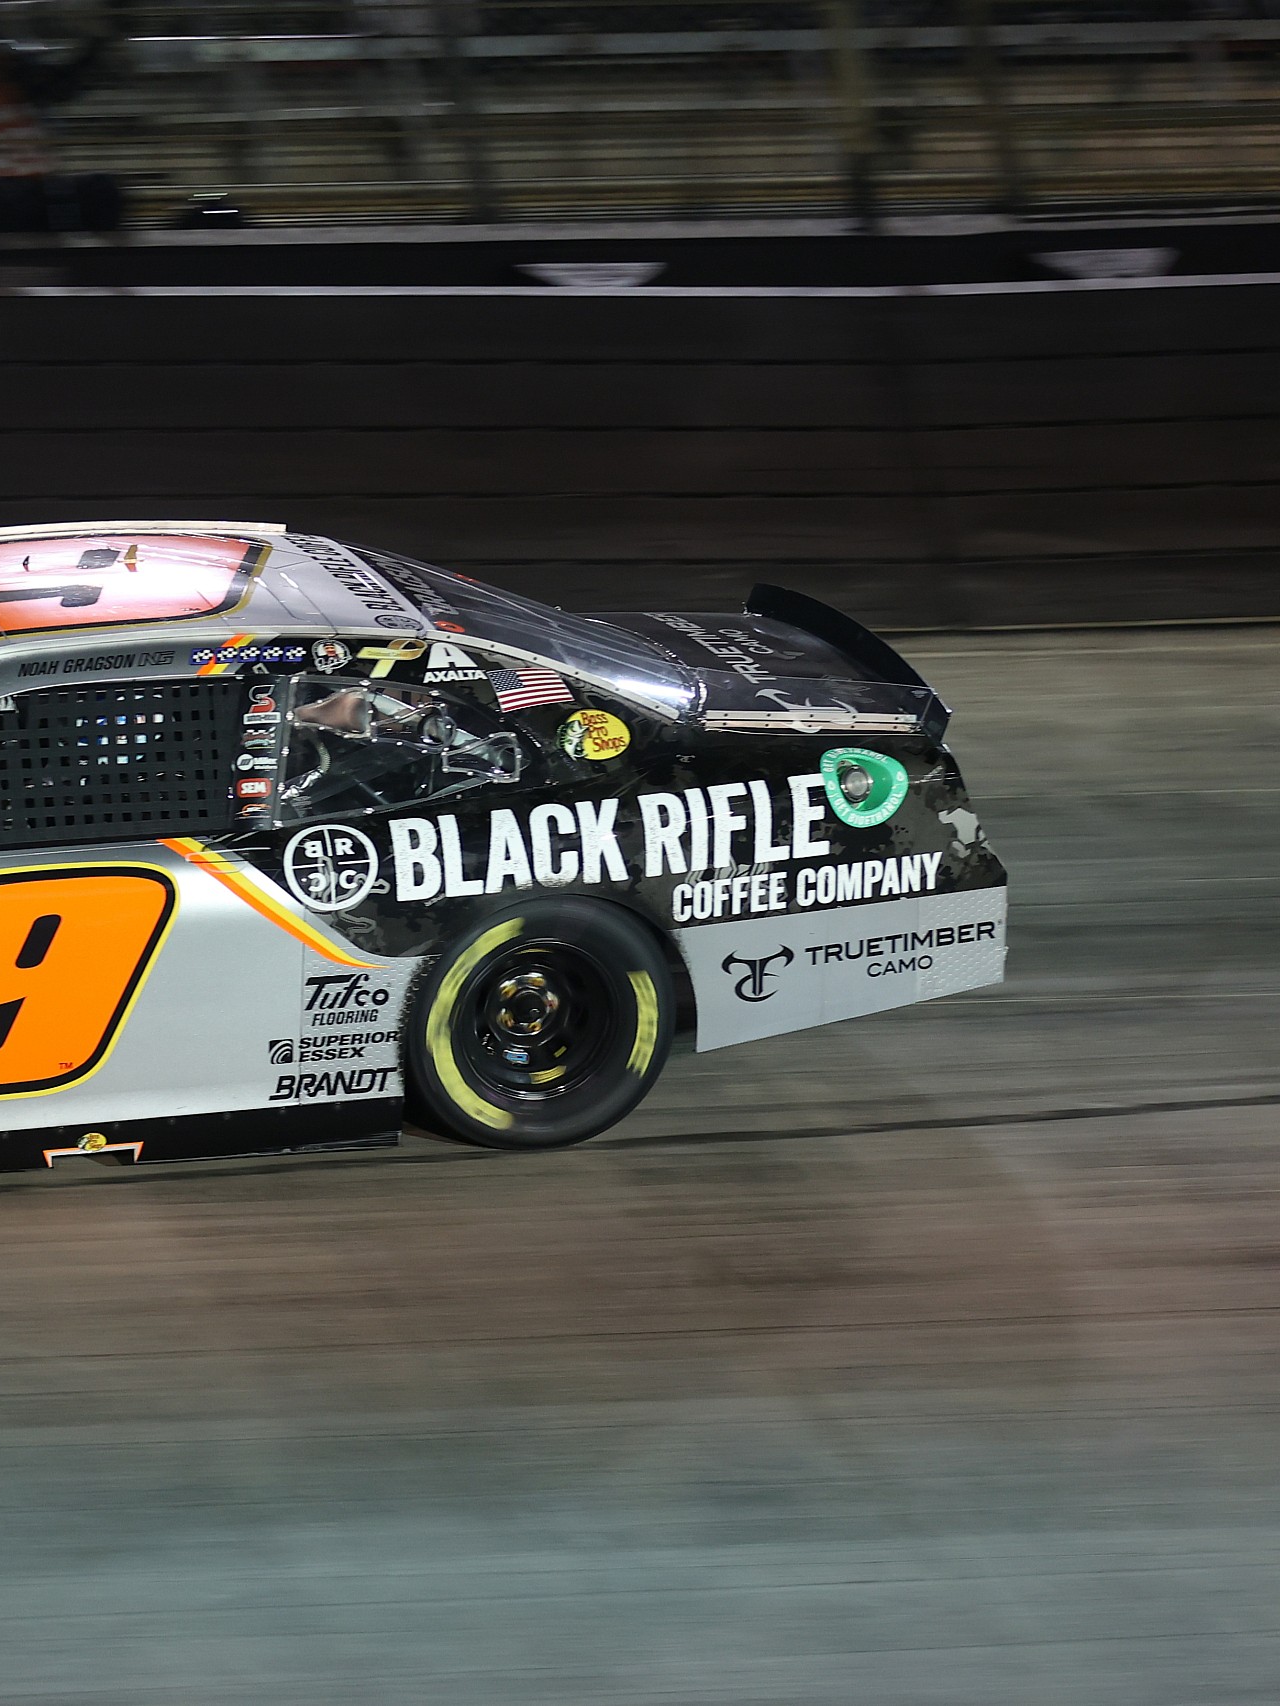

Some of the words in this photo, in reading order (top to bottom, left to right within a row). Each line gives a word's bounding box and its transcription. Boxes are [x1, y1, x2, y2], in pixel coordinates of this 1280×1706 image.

[340, 580, 407, 612] BLACK
[718, 628, 774, 655] CAMO
[18, 660, 57, 678] NOAH
[63, 653, 132, 674] GRAGSON
[423, 670, 488, 684] AXALTA
[580, 712, 609, 726] Bass
[588, 725, 608, 739] Pro
[593, 736, 626, 752] Shops
[240, 782, 267, 795] SEM
[388, 798, 629, 902] BLACK
[637, 773, 831, 879] RIFLE
[672, 869, 790, 923] COFFEE
[797, 851, 944, 908] COMPANY
[805, 921, 996, 966] TRUETIMBER
[866, 955, 933, 978] CAMO
[304, 973, 389, 1011] Tufco
[311, 1009, 379, 1026] FLOORING
[298, 1031, 400, 1049] SUPERIOR
[299, 1046, 367, 1062] ESSEX
[269, 1067, 397, 1101] BRANDT
